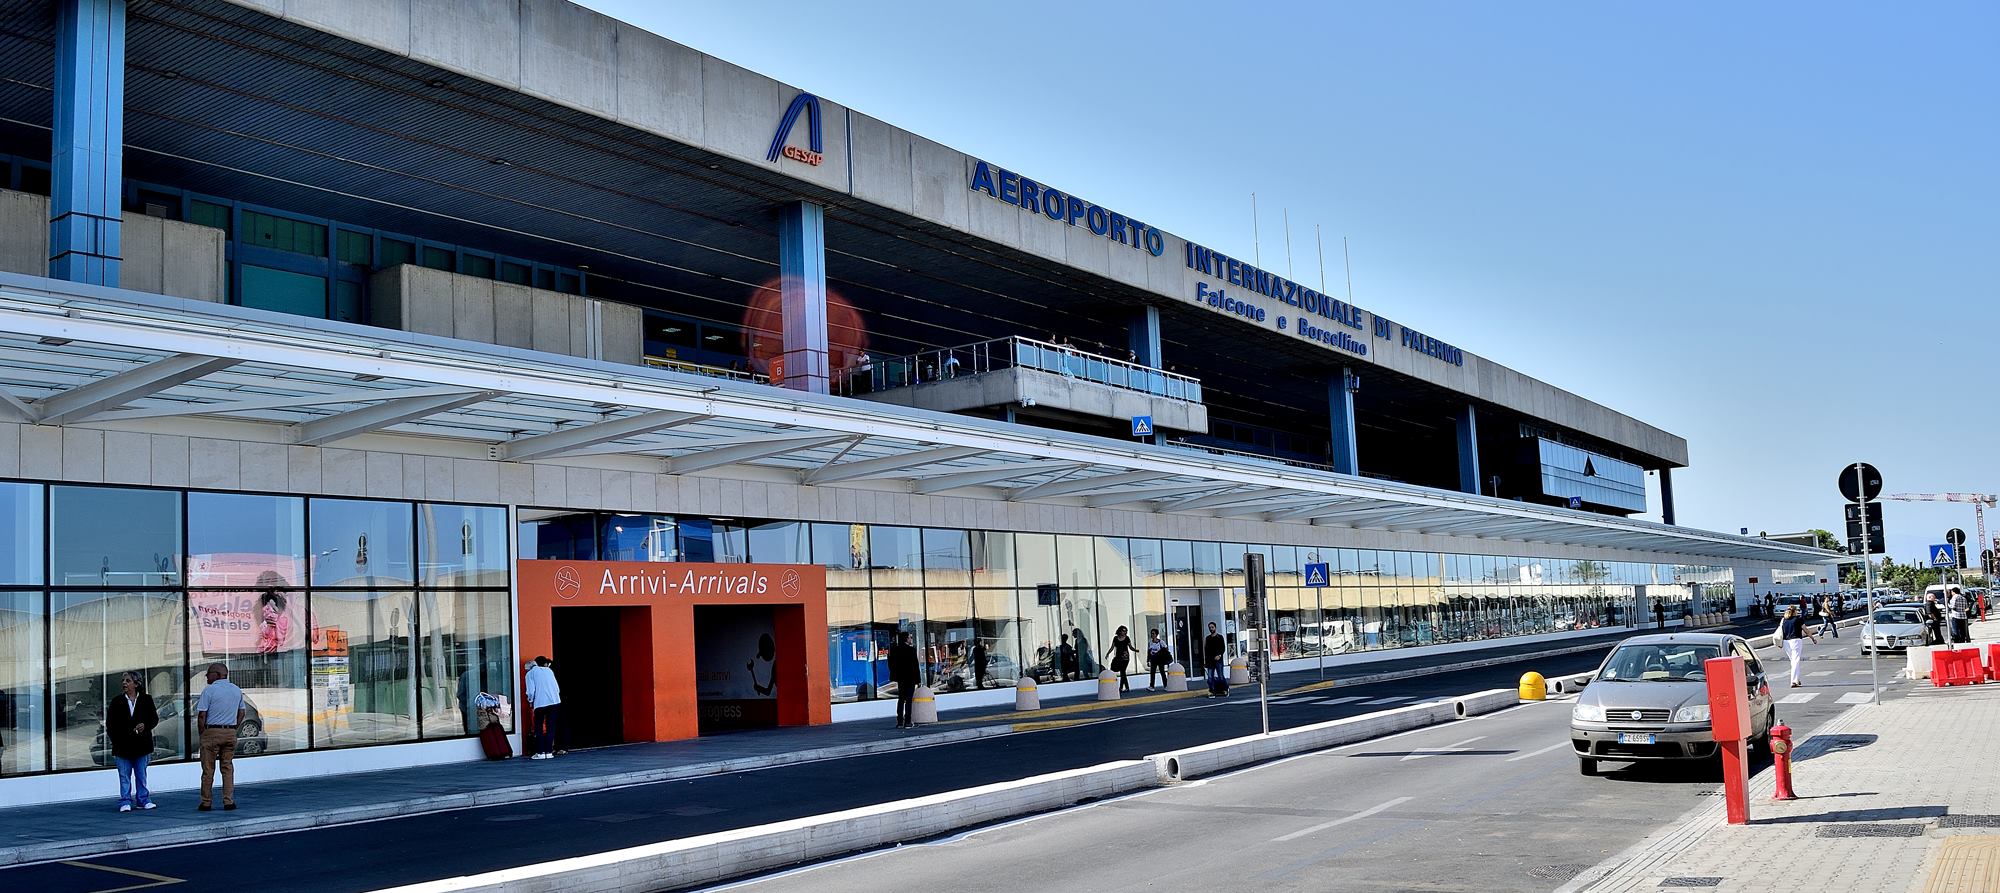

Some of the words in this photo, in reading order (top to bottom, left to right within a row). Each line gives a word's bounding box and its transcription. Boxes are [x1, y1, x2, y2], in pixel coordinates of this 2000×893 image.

[782, 144, 824, 167] GESAP
[970, 160, 1165, 257] AEROPORTO
[1186, 241, 1363, 331] INTERNAZIONALE
[1374, 315, 1391, 341] DI
[1401, 327, 1463, 367] PALERMO
[1196, 281, 1265, 322] Falcone
[1277, 315, 1287, 330] e
[1299, 317, 1368, 357] Borsellino
[776, 366, 782, 376] B
[600, 568, 768, 595] Arrivi-Arrivals
